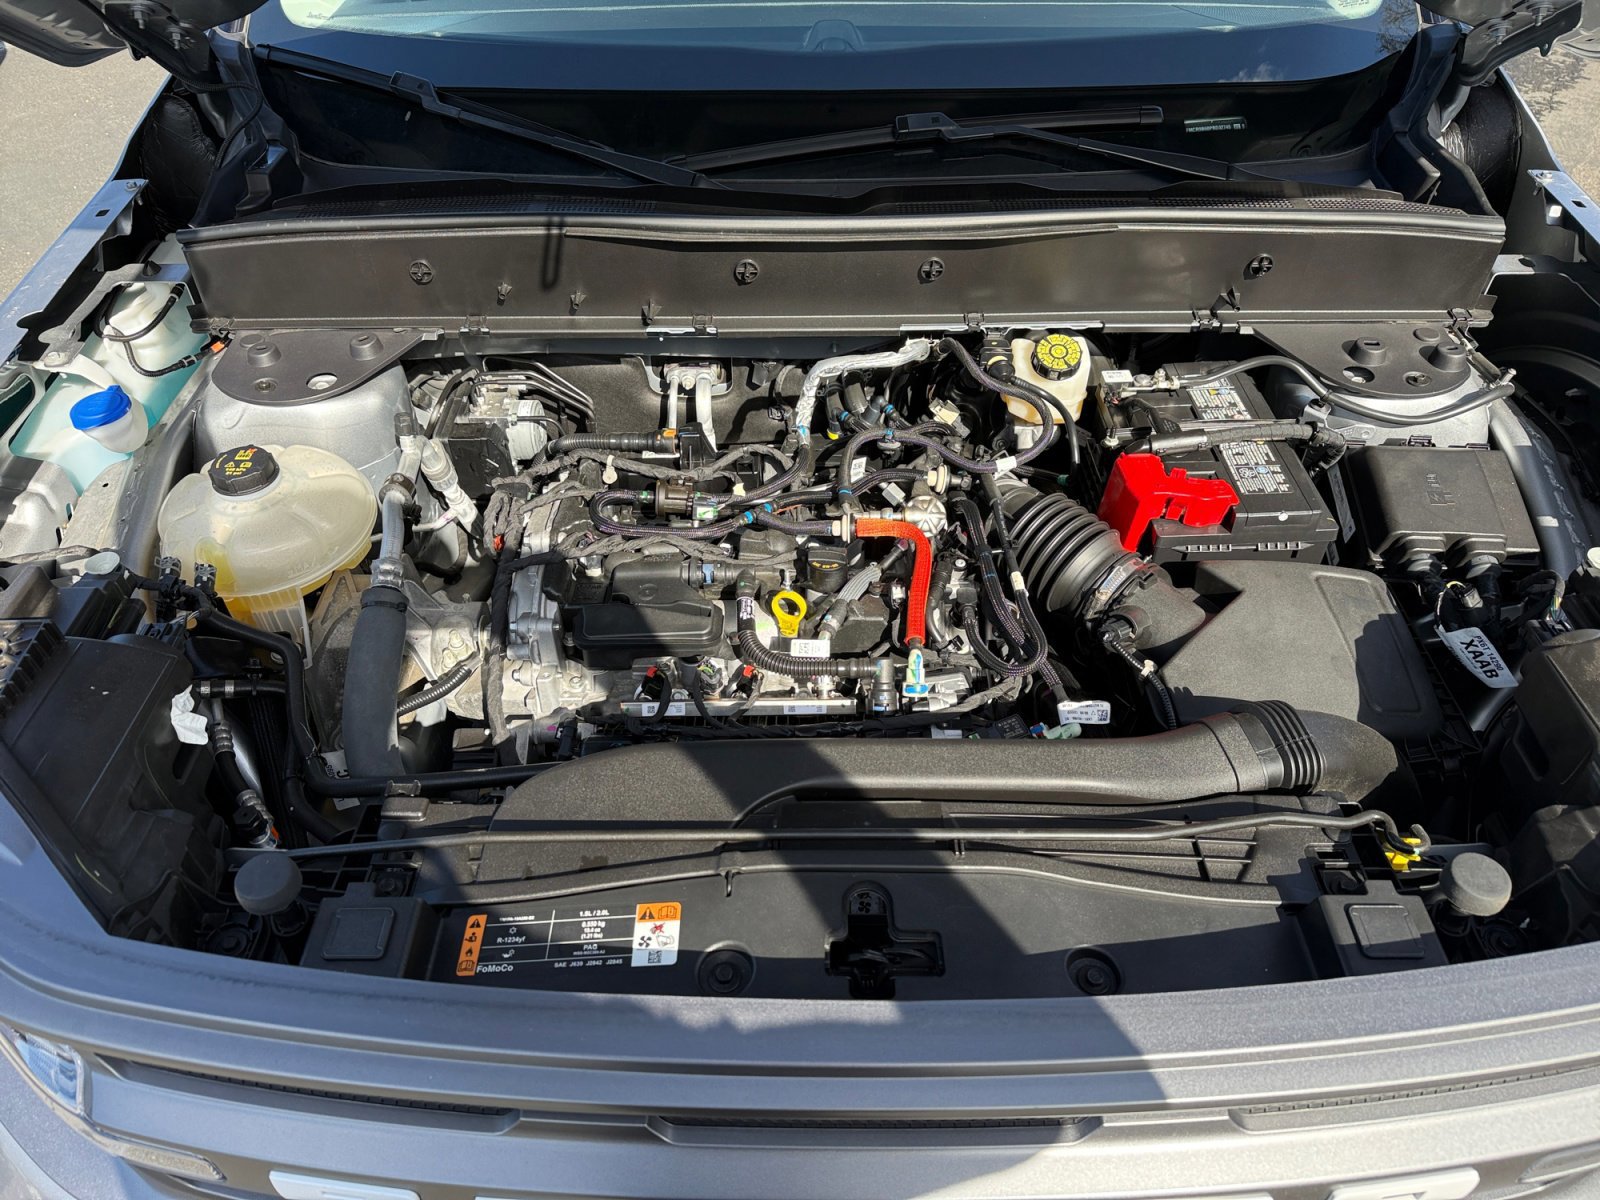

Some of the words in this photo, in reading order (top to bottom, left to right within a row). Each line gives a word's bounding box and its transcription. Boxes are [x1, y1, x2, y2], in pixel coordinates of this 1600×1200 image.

[1460, 638, 1499, 679] XAAB
[496, 936, 526, 944] R-1234yf
[476, 964, 514, 973] FoMoCo
